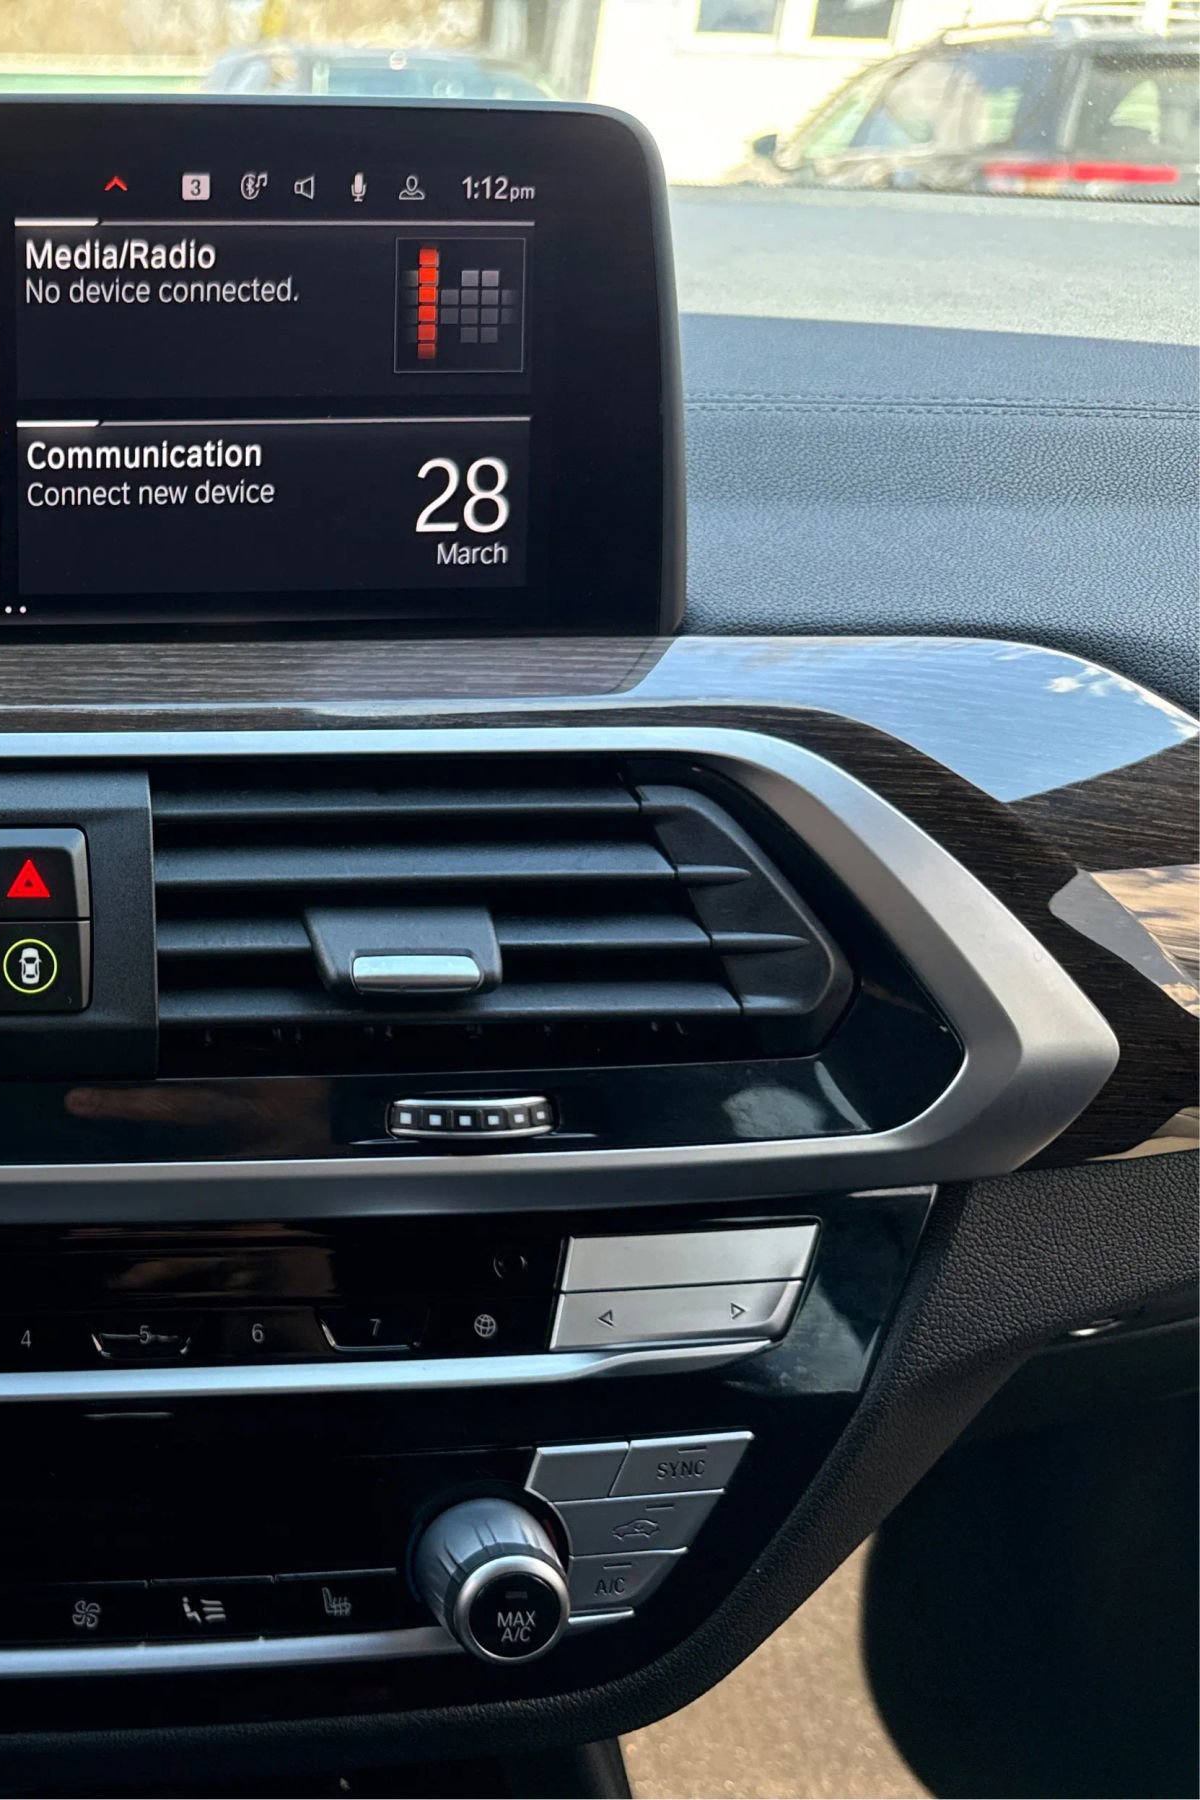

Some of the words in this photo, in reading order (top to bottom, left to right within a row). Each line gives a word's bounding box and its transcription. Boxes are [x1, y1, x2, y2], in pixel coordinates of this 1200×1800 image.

[190, 179, 202, 196] 3
[462, 175, 536, 203] 1:12pm
[25, 238, 216, 270] Media/Radio
[25, 277, 61, 304] No
[69, 276, 151, 304] device
[158, 275, 300, 303] connected.
[26, 440, 263, 470] Communication
[26, 481, 131, 507] Connect
[138, 484, 189, 505] new
[195, 479, 276, 505] device
[415, 456, 510, 534] 28
[436, 541, 509, 566] March
[138, 1325, 151, 1345] 5
[251, 1323, 264, 1344] 6
[368, 1318, 382, 1337] 7
[20, 1329, 32, 1348] 4
[657, 1459, 706, 1481] SYNC
[594, 1577, 626, 1596] A/C
[497, 1610, 537, 1629] MAX
[501, 1626, 531, 1642] A/C
